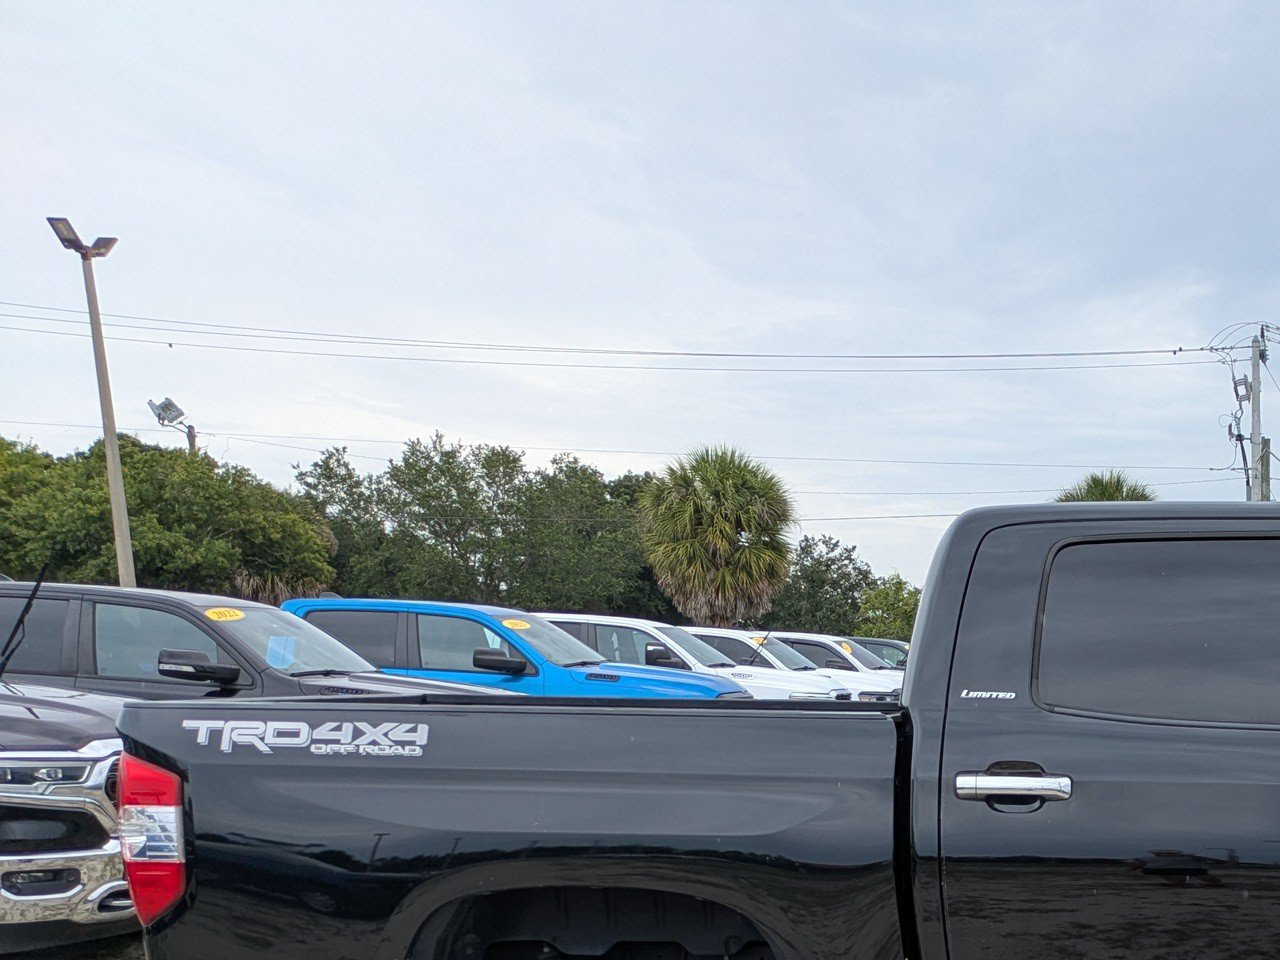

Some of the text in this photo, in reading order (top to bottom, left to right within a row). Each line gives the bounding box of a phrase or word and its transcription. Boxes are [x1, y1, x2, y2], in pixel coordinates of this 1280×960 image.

[182, 720, 312, 753] TRD
[310, 743, 424, 757] OFF ROAD
